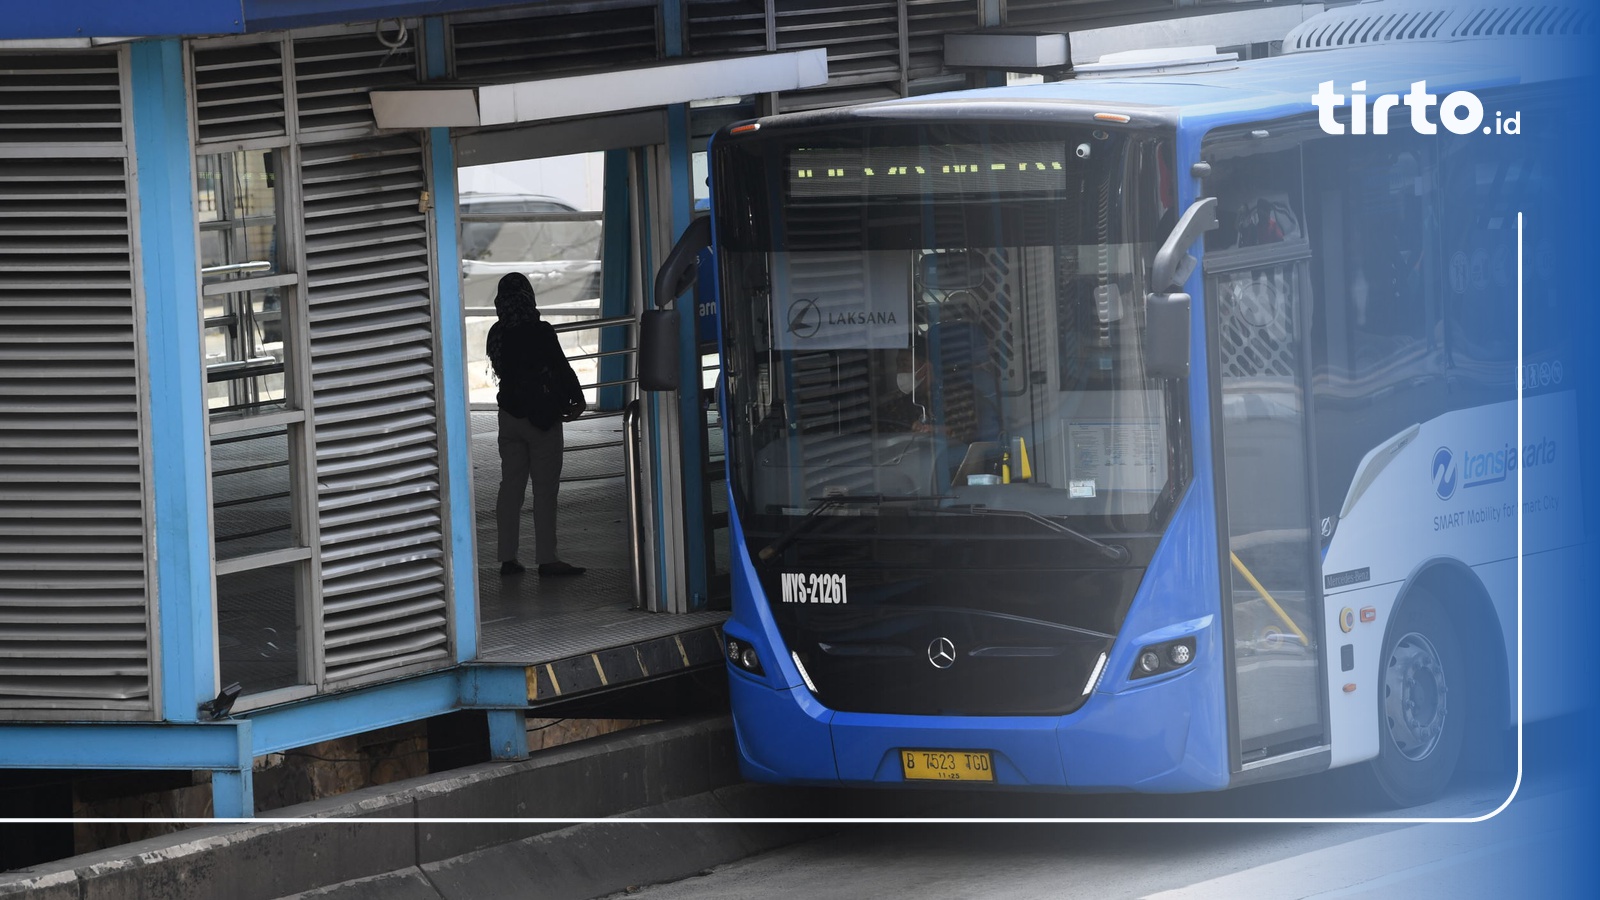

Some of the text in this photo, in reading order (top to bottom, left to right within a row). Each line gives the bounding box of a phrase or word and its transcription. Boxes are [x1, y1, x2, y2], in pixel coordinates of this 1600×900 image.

[828, 311, 897, 325] LAKSANA
[1433, 495, 1559, 531] SMART Mobility for mart City
[781, 573, 847, 604] MYS-21261
[907, 753, 989, 771] B 7523 TGD
